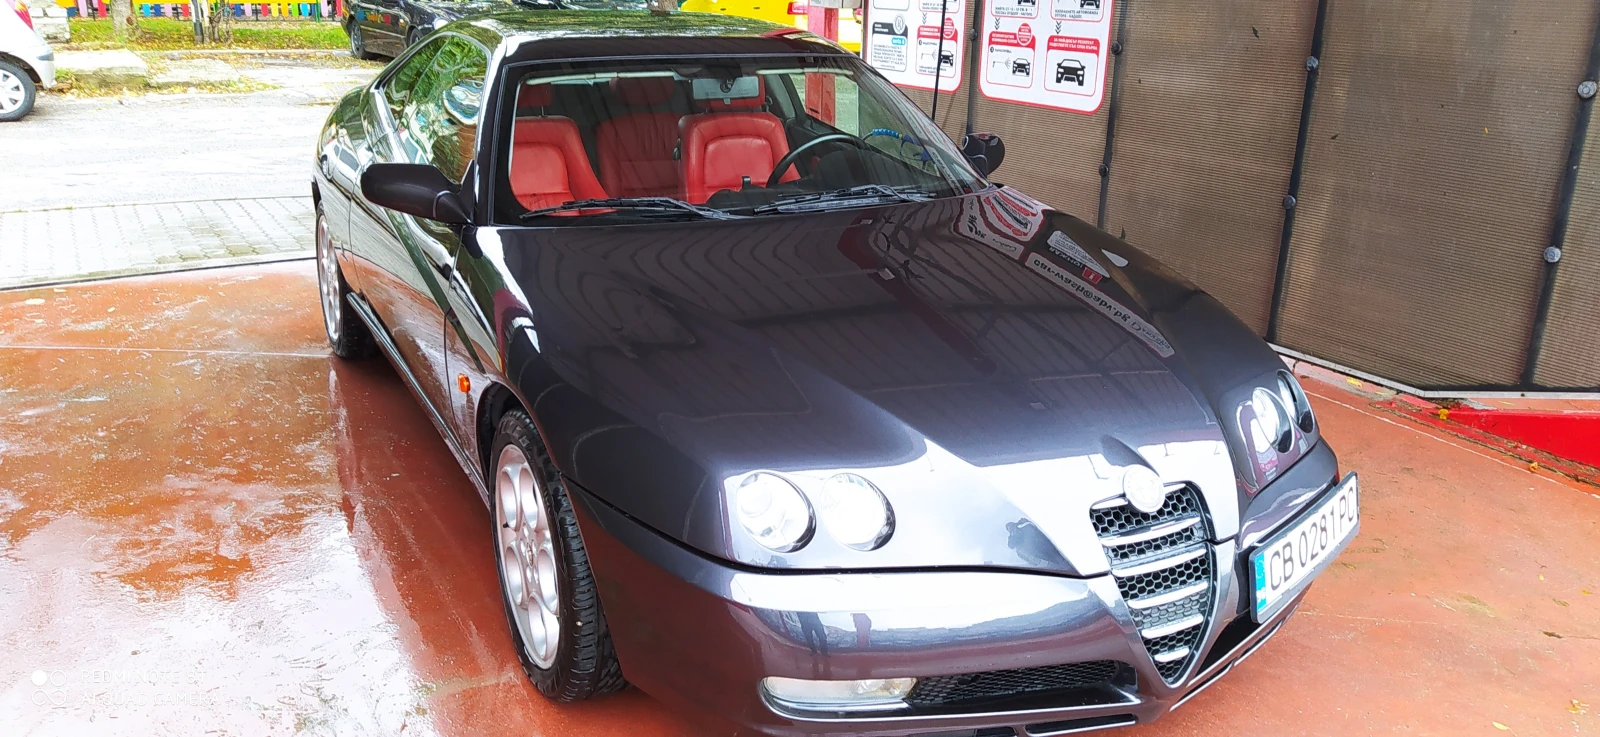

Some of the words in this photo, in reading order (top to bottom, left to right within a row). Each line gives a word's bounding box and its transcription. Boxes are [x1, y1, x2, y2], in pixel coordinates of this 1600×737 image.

[1270, 543, 1294, 591] CB
[1298, 508, 1336, 568] 0281
[1339, 487, 1355, 533] PC
